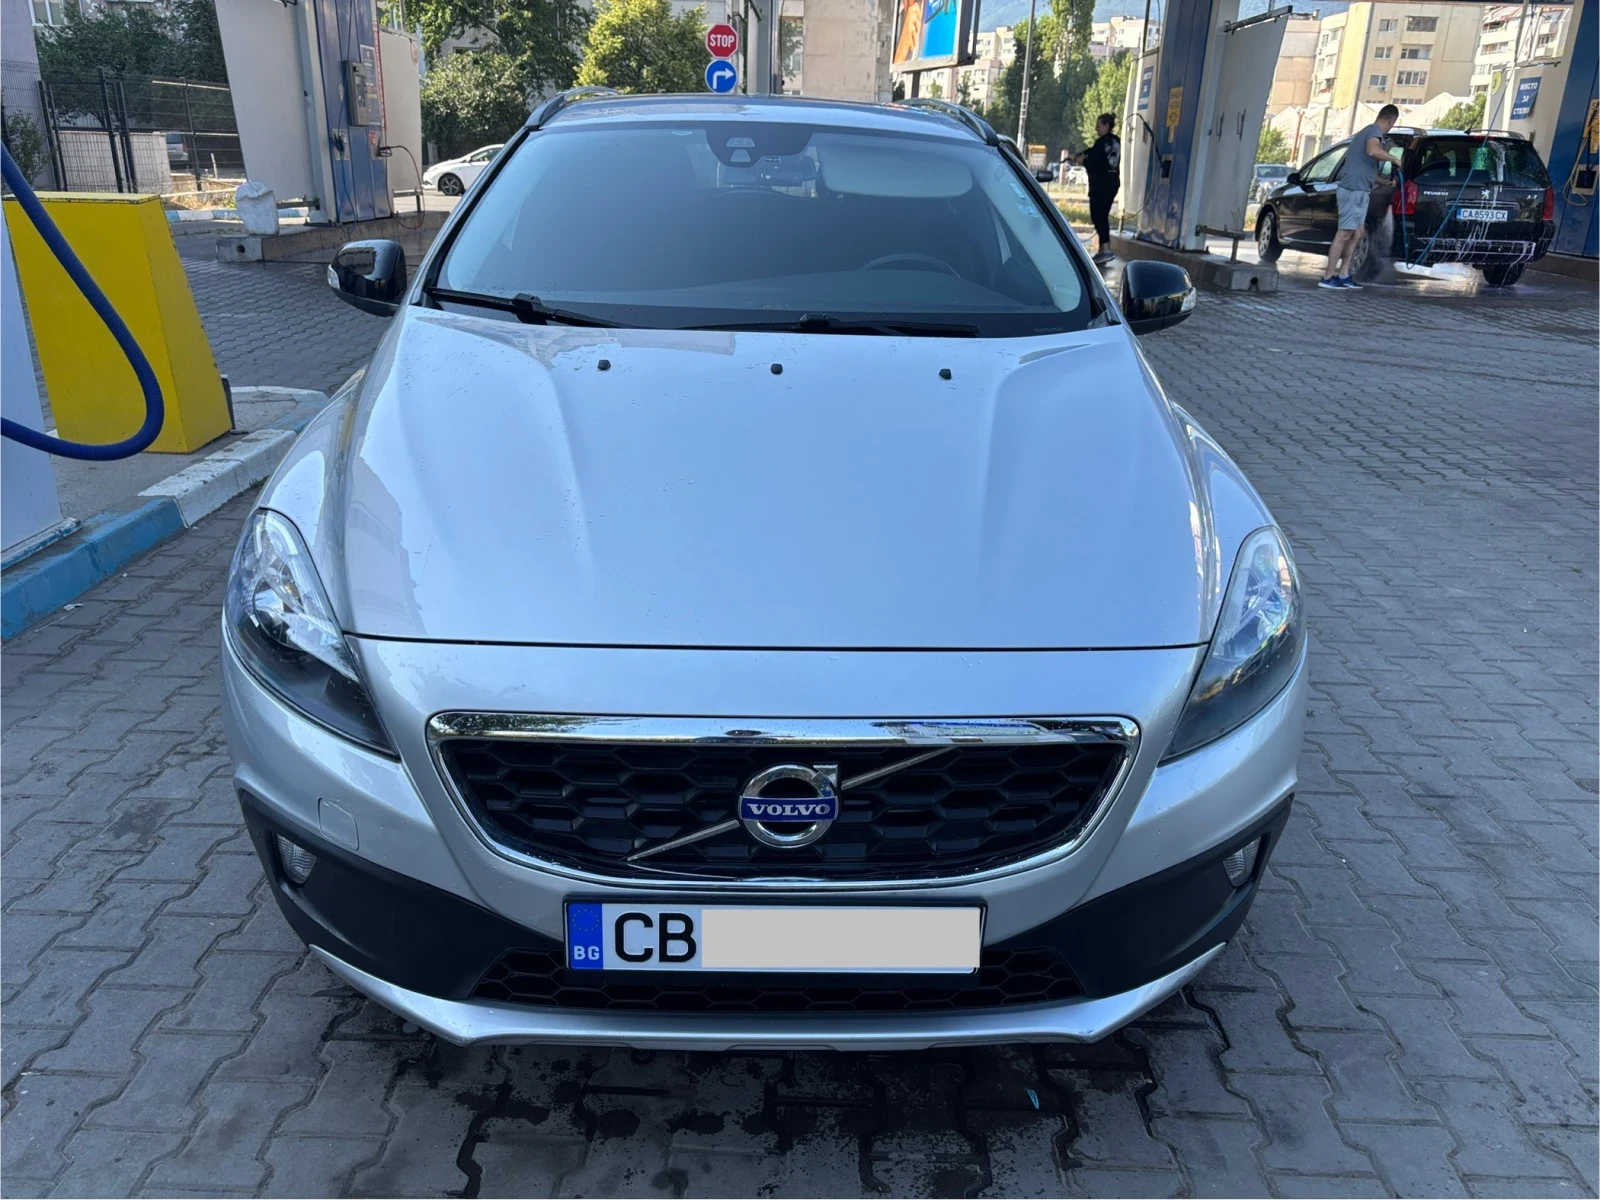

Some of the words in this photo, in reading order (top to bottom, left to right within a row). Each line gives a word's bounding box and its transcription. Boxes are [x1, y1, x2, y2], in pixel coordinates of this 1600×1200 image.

[710, 34, 735, 47] STOP
[747, 803, 831, 816] VOLVO
[615, 912, 697, 963] CB
[573, 945, 600, 960] BG
